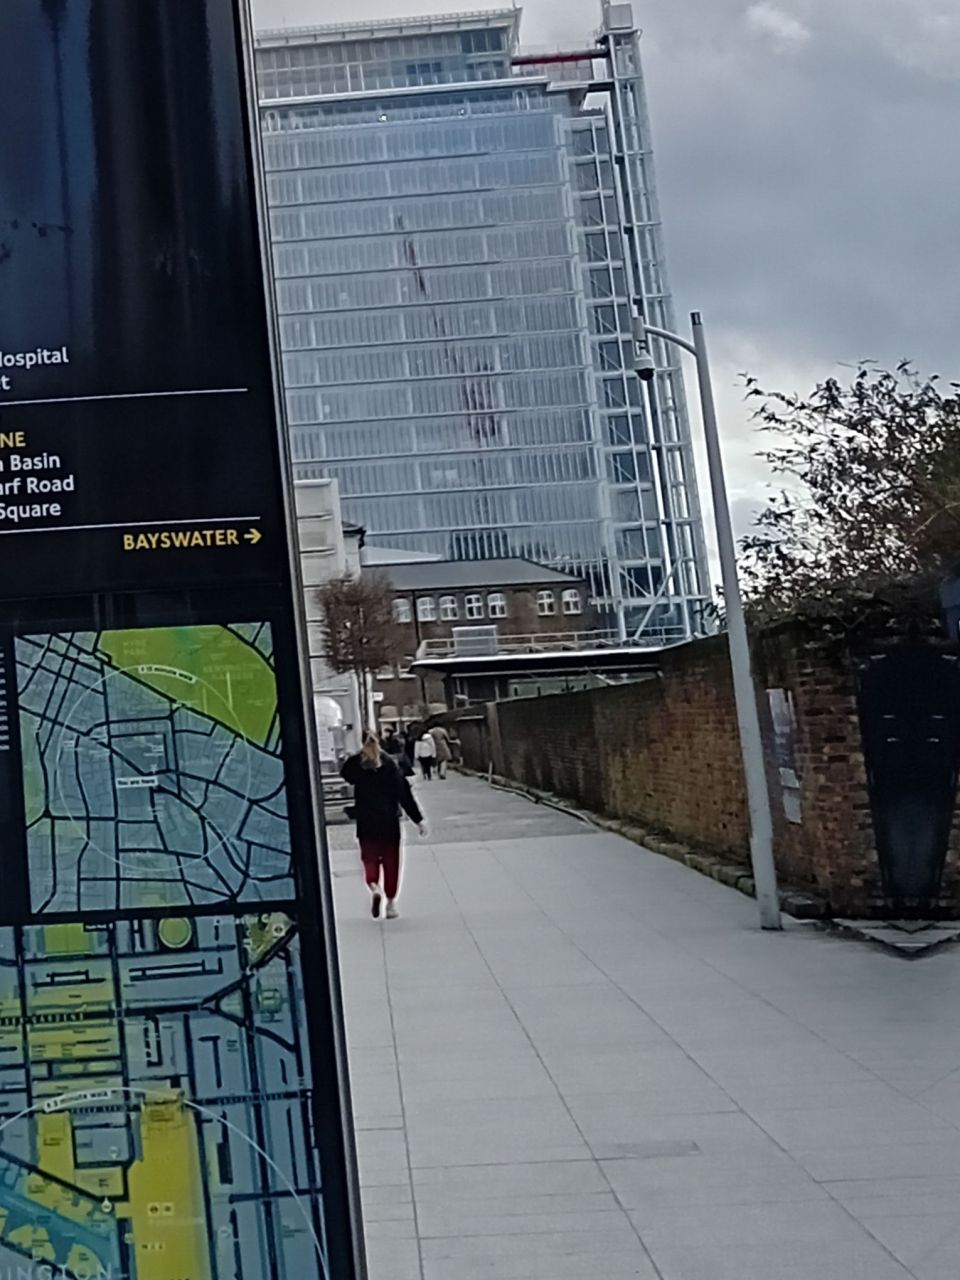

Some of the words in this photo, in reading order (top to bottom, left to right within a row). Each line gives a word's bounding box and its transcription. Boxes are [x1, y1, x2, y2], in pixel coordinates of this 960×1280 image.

[10, 453, 61, 470] Basin
[26, 475, 75, 493] Road
[123, 529, 239, 550] BAYSWATER
